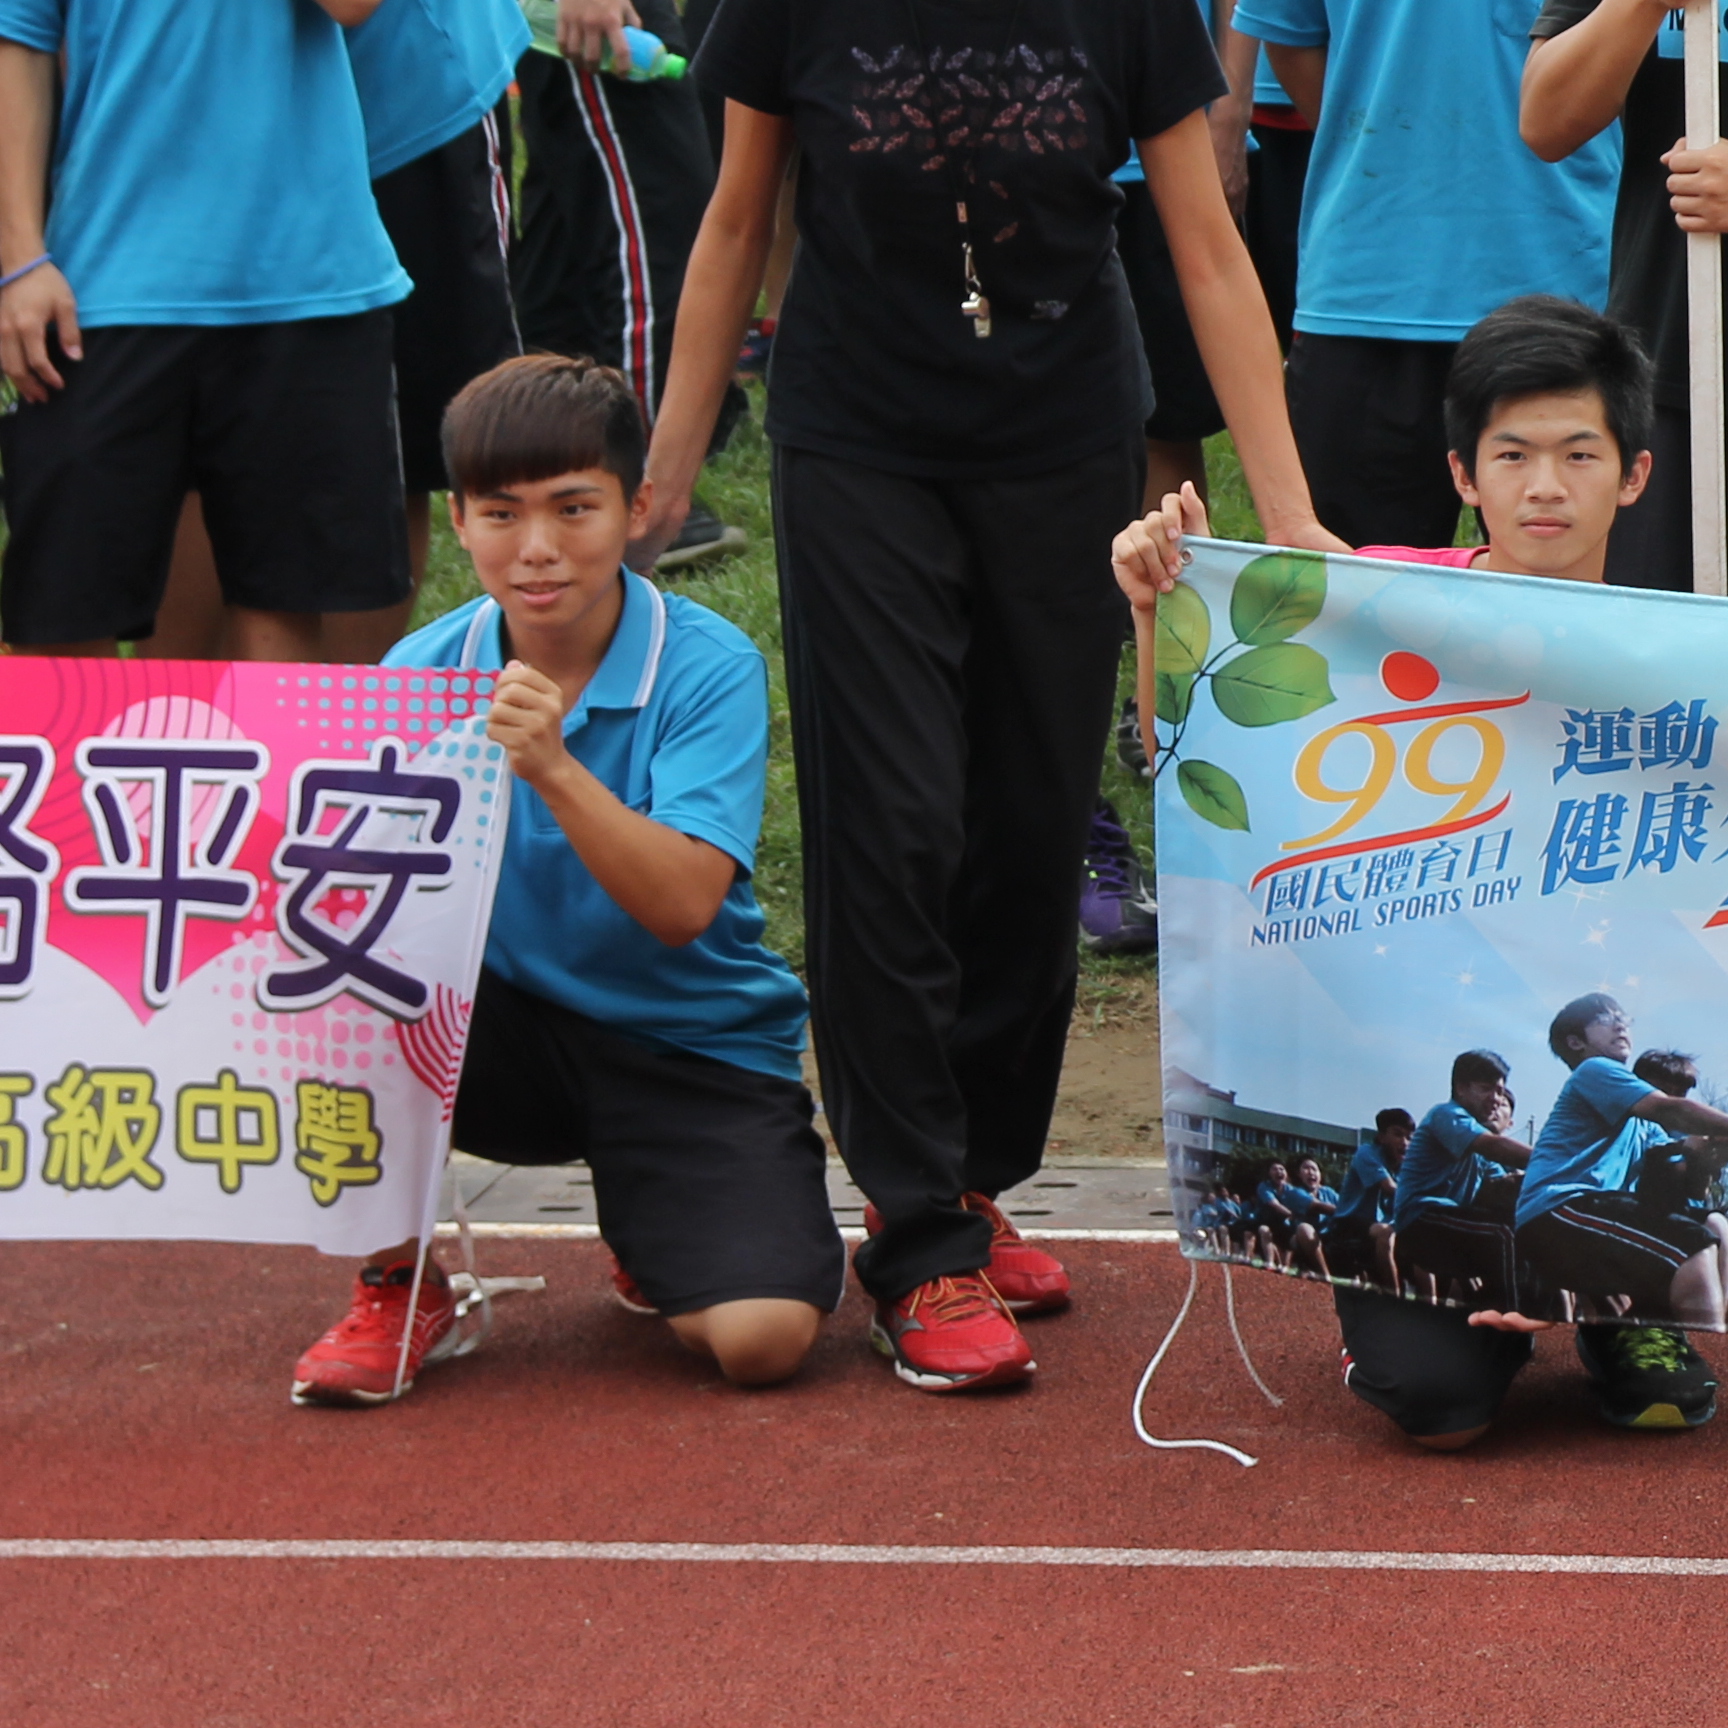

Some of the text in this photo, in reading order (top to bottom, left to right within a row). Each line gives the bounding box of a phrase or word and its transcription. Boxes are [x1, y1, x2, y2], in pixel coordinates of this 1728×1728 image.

[0, 737, 467, 1018] 平安
[1250, 875, 1522, 947] NATIONAL SPORTS DAY
[1265, 827, 1514, 917] 國民體育日
[0, 1065, 385, 1206] 級中學
